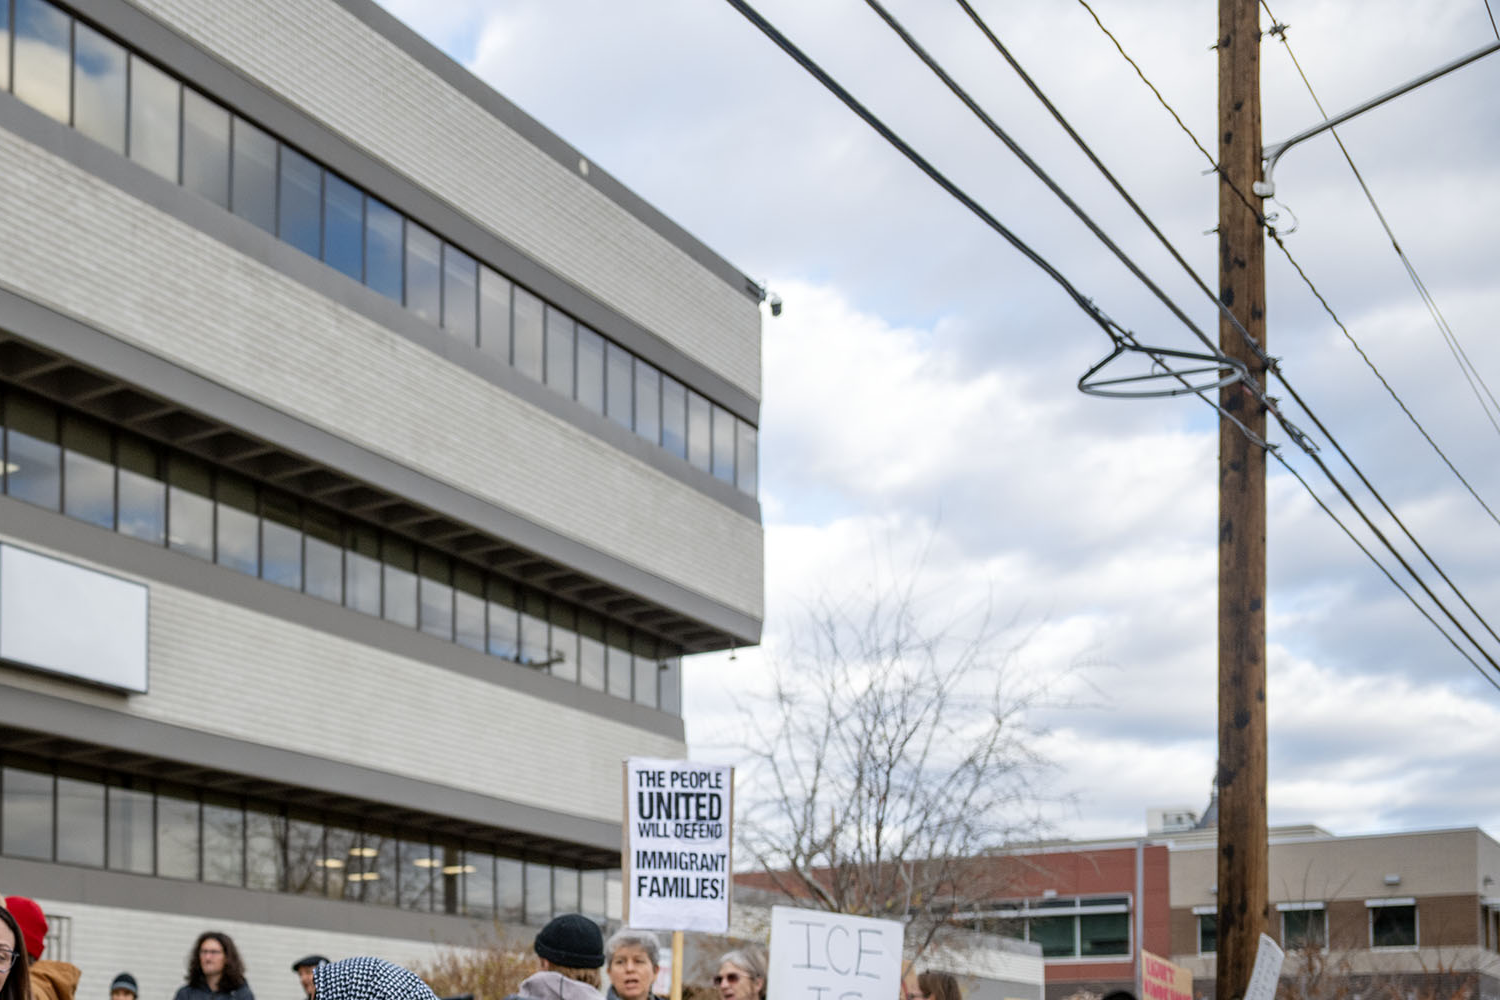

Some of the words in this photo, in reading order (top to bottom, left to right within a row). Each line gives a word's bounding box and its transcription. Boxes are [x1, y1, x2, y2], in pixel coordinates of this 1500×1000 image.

[636, 770, 666, 789] THE
[670, 771, 723, 790] PEOPLE
[637, 791, 723, 822] UNITED
[638, 822, 671, 839] WILL
[674, 821, 723, 840] DEFEND
[636, 850, 727, 873] IMMIGRANT
[637, 875, 725, 900] FAMILIES!
[789, 919, 884, 980] ICE
